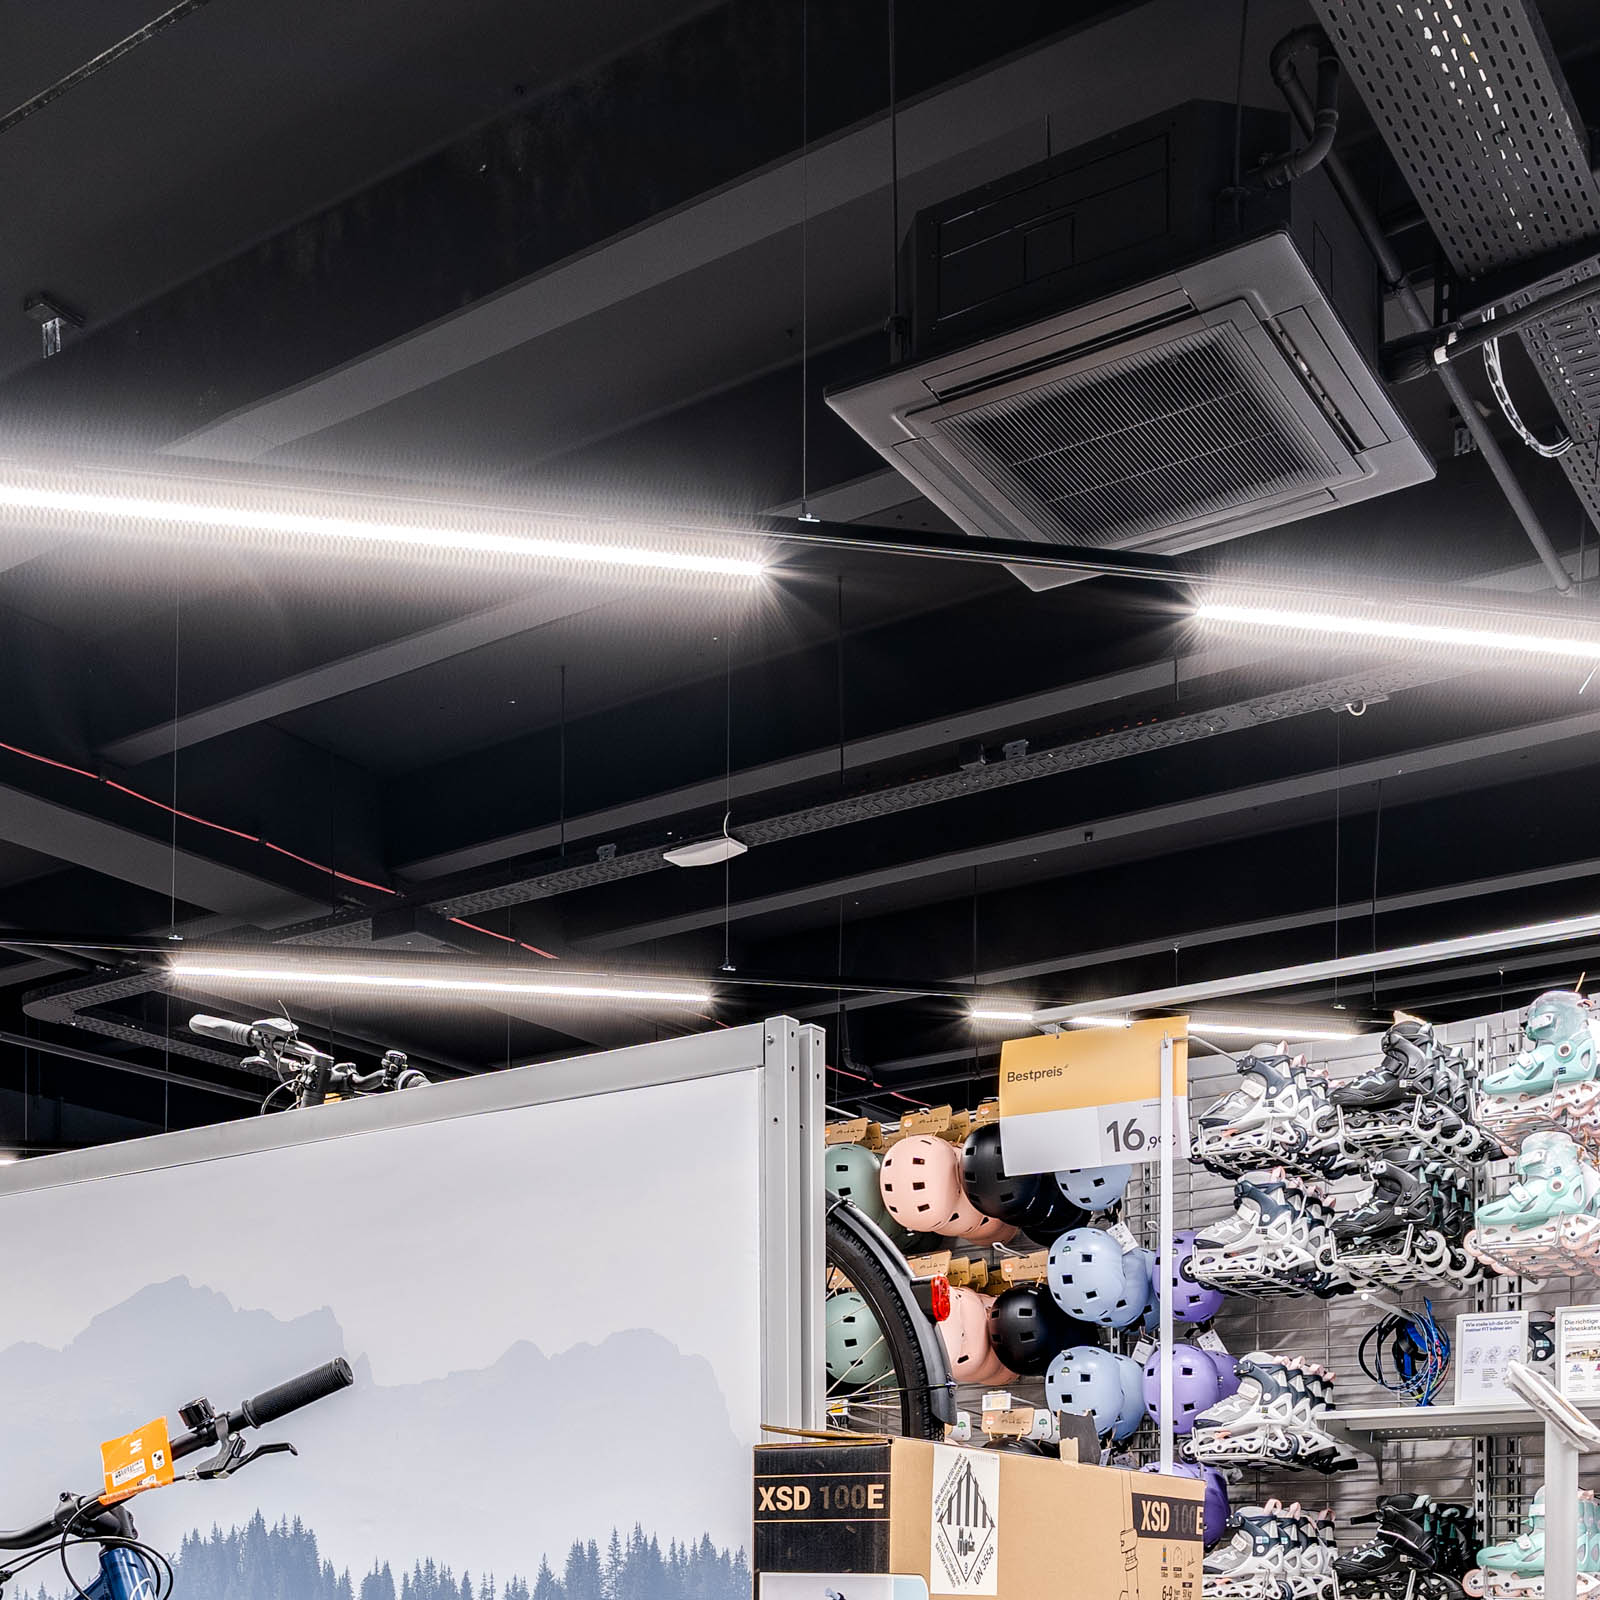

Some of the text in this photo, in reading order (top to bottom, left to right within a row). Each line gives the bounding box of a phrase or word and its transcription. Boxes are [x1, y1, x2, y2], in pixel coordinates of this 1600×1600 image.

[1007, 1066, 1063, 1082] Bestpreis
[758, 1483, 886, 1511] XSD 100E
[1141, 1500, 1204, 1535] XSD 100E
[974, 1545, 995, 1585] UN 3556
[1162, 1585, 1173, 1600] 6-9
